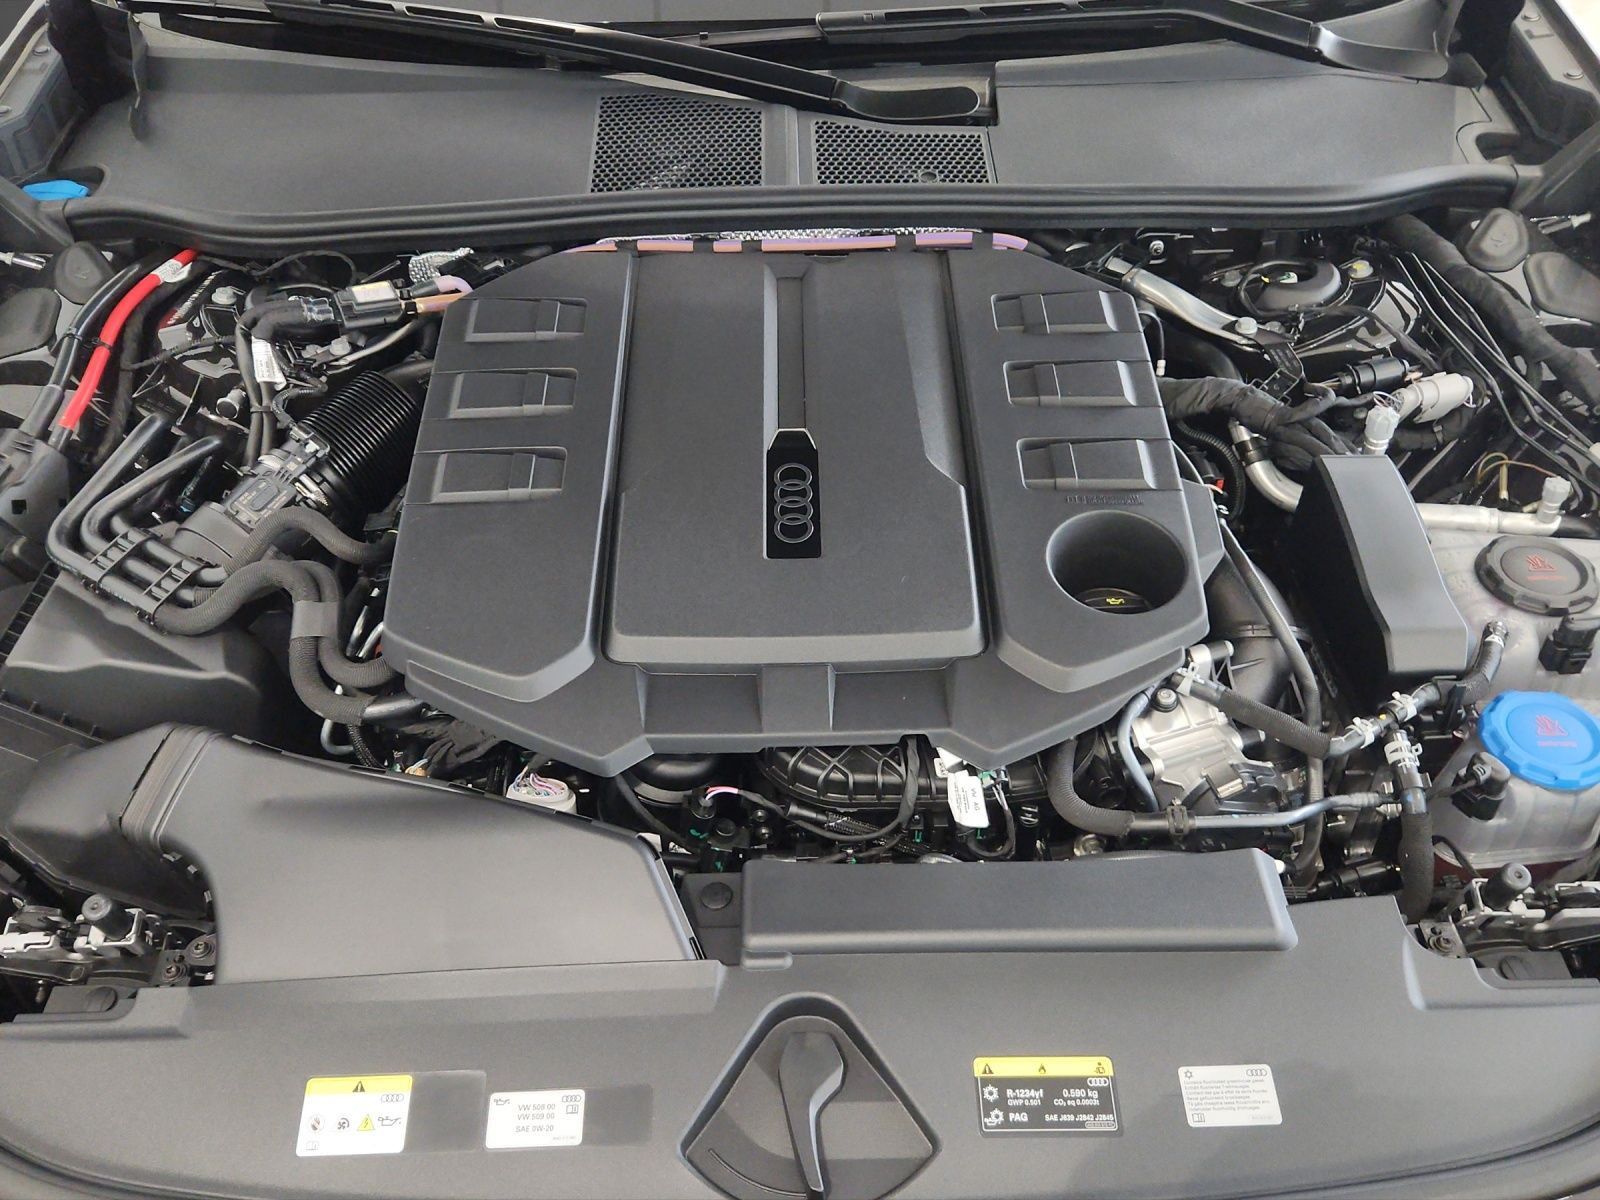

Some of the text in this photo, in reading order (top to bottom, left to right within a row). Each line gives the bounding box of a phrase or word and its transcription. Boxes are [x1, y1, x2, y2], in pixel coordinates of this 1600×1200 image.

[1087, 1088, 1098, 1099] kg
[518, 1103, 531, 1111] VW
[517, 1113, 531, 1121] VW
[1009, 1112, 1028, 1122] PAG
[1044, 1113, 1058, 1121] SAE
[515, 1125, 530, 1133] SAE
